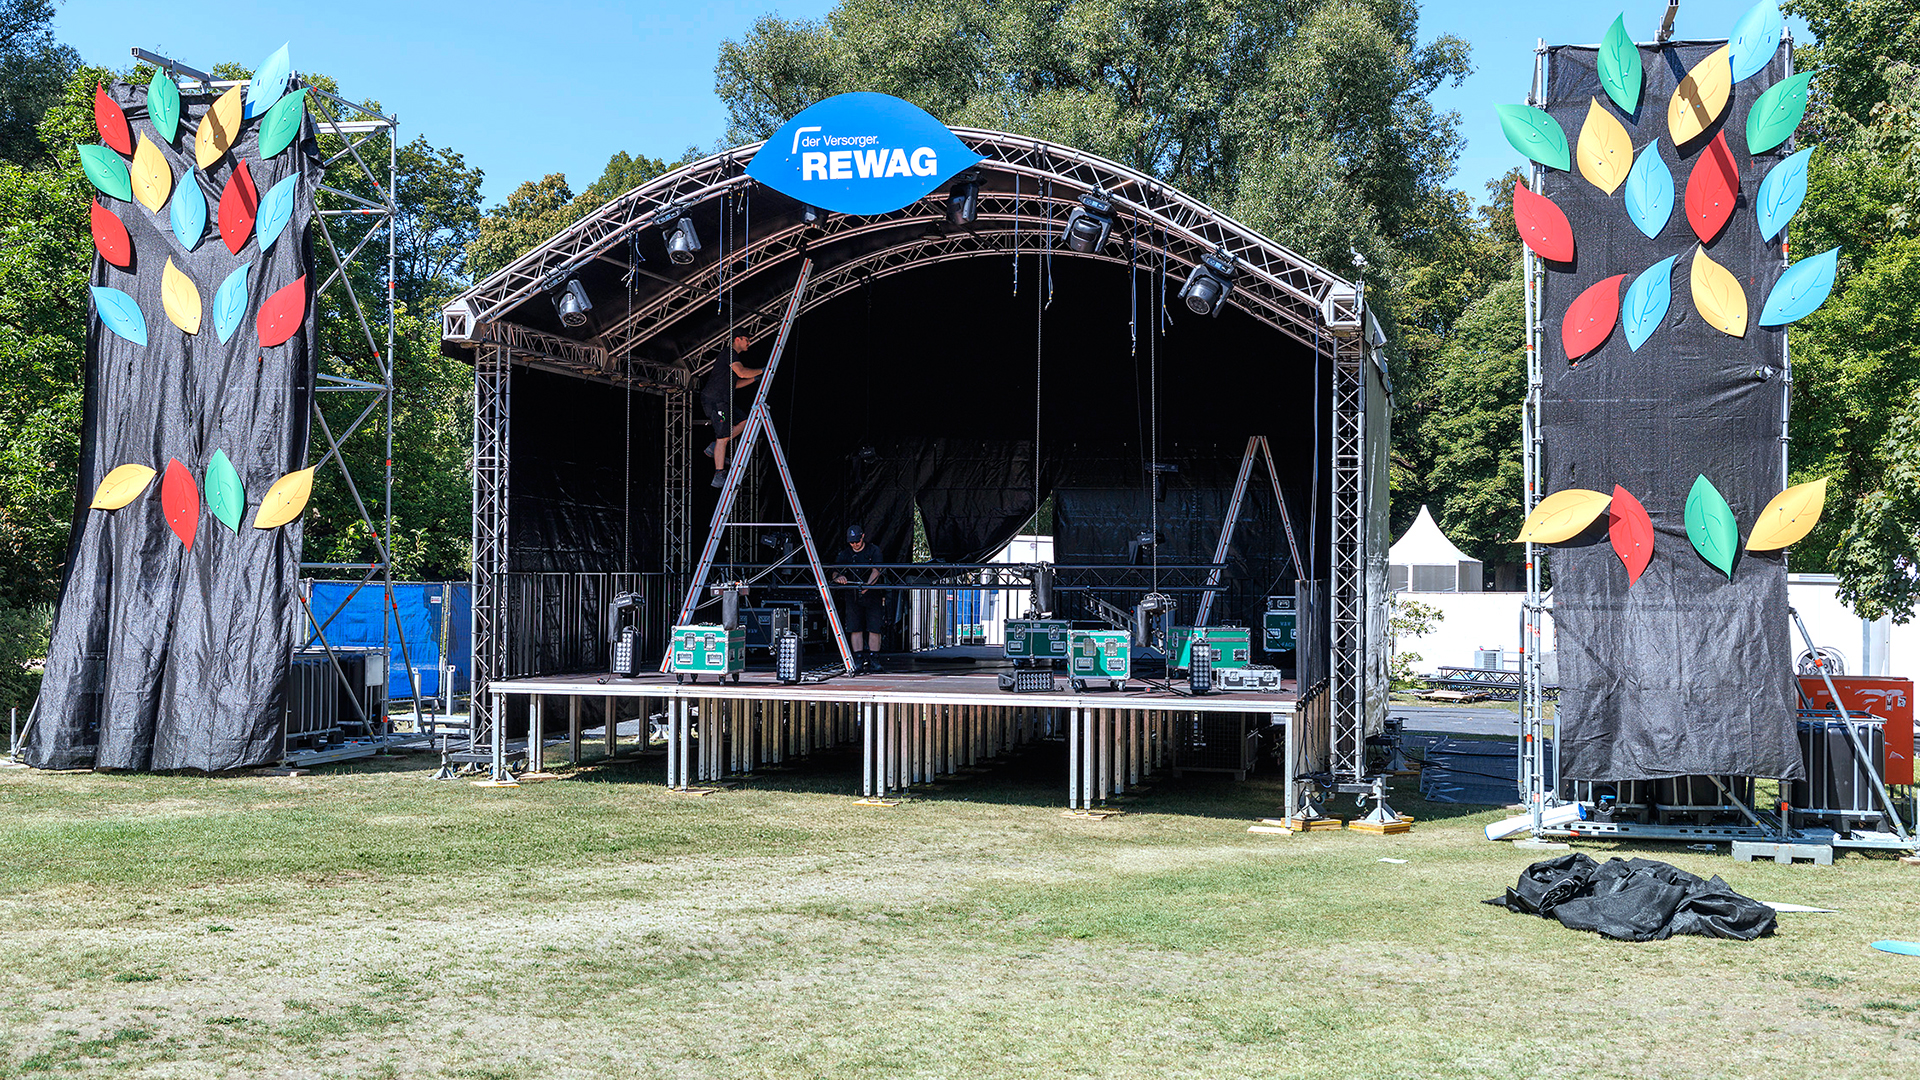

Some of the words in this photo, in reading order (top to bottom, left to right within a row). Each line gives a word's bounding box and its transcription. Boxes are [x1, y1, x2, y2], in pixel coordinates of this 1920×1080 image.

[801, 136, 821, 147] der
[823, 135, 879, 147] Versorger.
[802, 146, 937, 181] REWAG
